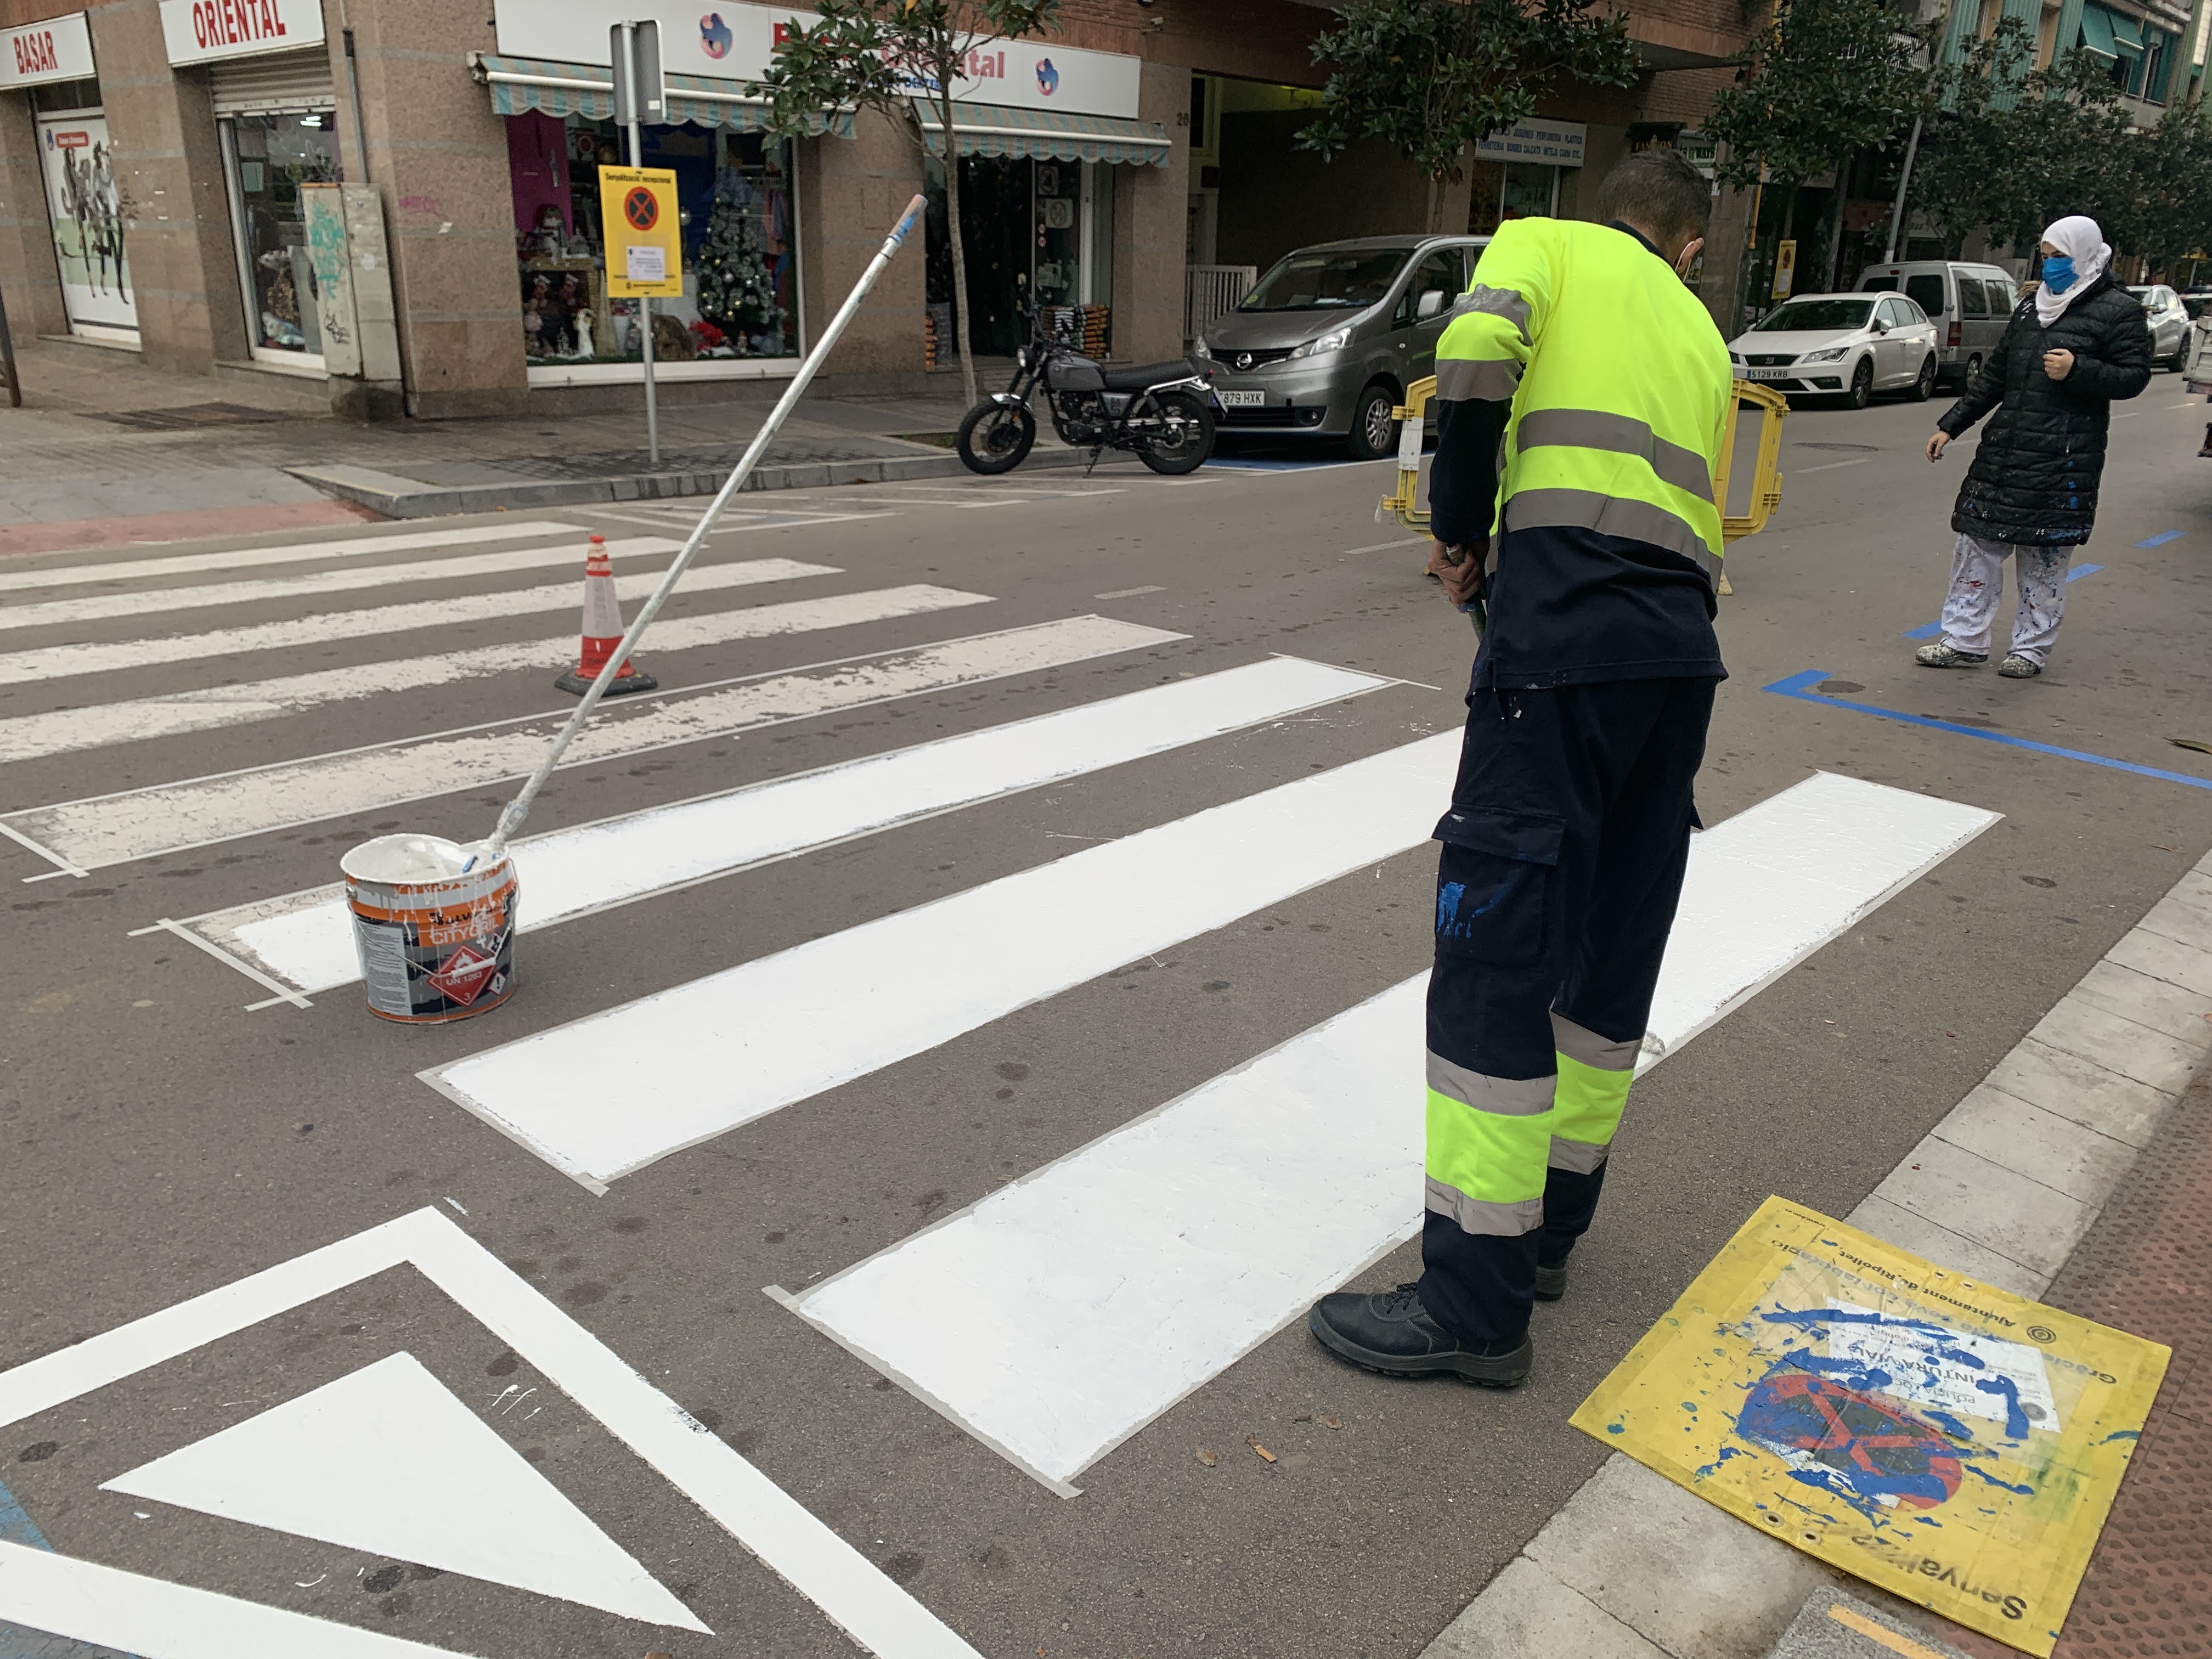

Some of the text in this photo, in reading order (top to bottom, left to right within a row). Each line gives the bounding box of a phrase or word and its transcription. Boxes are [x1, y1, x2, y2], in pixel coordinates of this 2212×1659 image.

[193, 0, 286, 48] ORIENTAL
[13, 31, 59, 74] BASAR
[1244, 392, 1262, 404] HXK
[445, 977, 461, 986] UN
[464, 992, 471, 1001] 3
[1836, 1250, 2017, 1329] Ajuntament de Ripollet
[1854, 1346, 1974, 1384] INTURA VIAL
[2039, 1352, 2117, 1386] Gràcie
